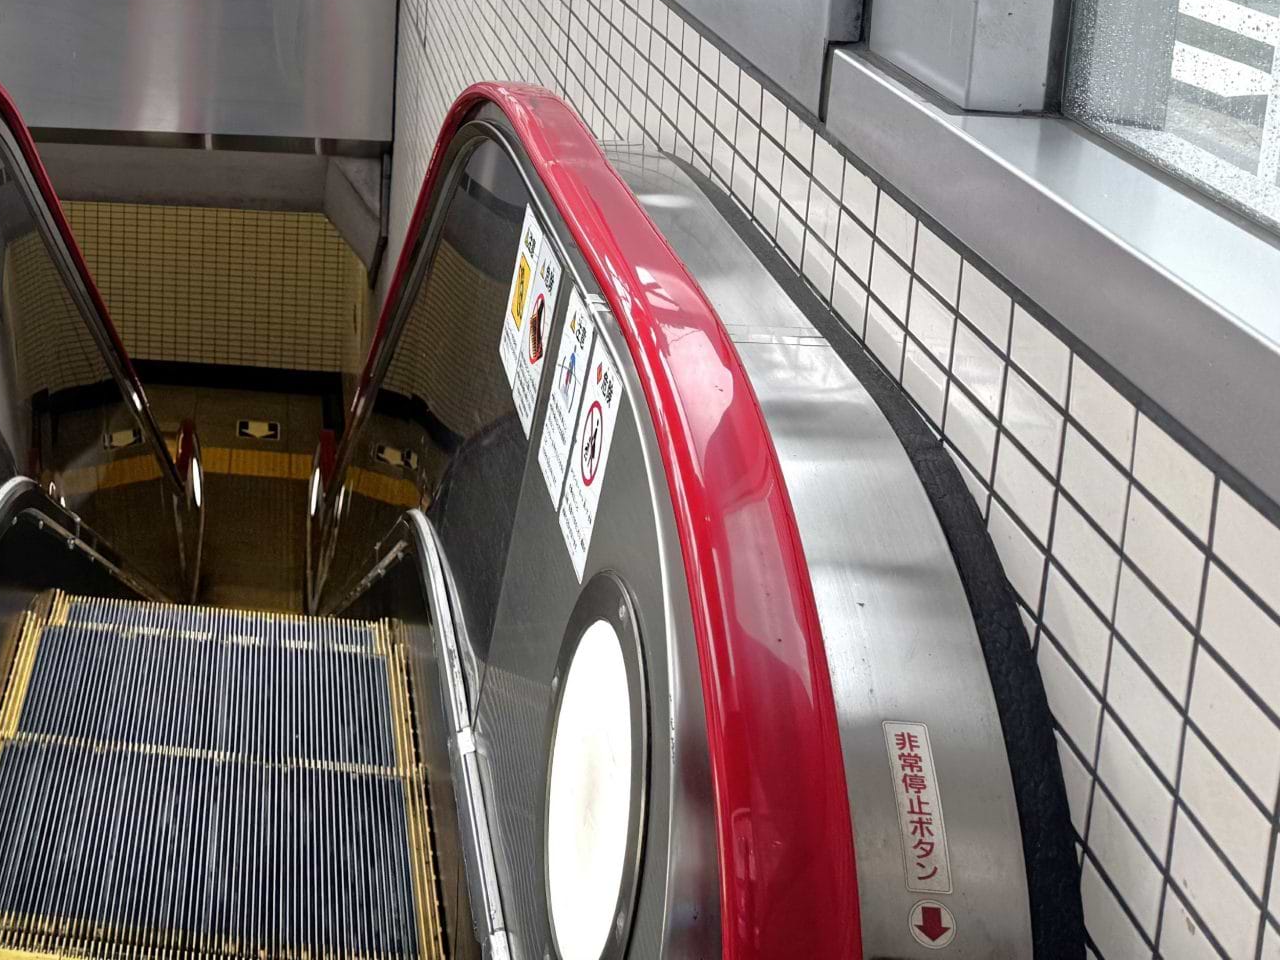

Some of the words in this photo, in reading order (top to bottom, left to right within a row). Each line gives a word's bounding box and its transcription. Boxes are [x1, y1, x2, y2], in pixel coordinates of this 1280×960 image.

[894, 731, 938, 881] 非常停止ボタン
